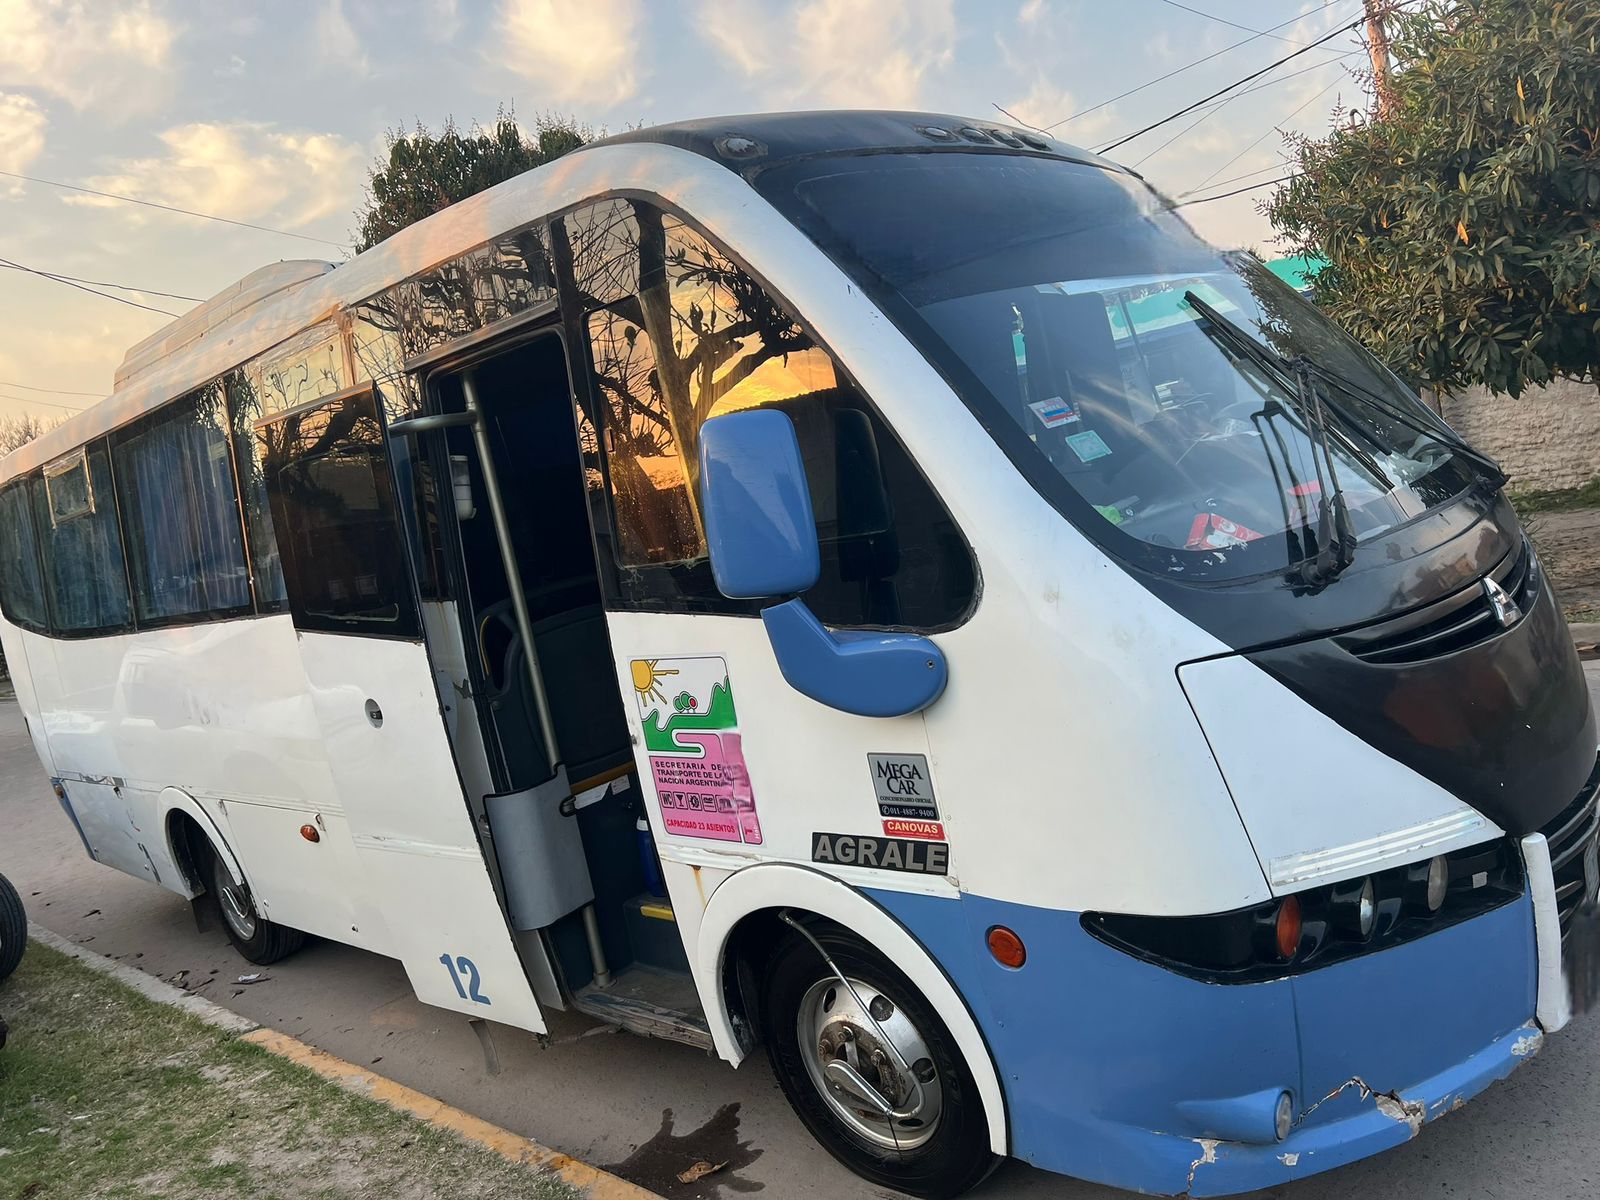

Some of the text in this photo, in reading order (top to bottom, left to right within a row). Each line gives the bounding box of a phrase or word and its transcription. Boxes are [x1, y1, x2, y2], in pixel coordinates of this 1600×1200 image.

[655, 761, 706, 770] SECRETARIA
[656, 769, 702, 778] TRANSPORTE
[877, 760, 923, 780] MEGA
[886, 777, 920, 796] CAR
[666, 819, 697, 830] CAPACIDAD
[706, 823, 736, 834] ASIENTOS
[887, 821, 938, 835] CANOVAS
[814, 835, 947, 873] AGRALE
[439, 953, 491, 1006] 12
